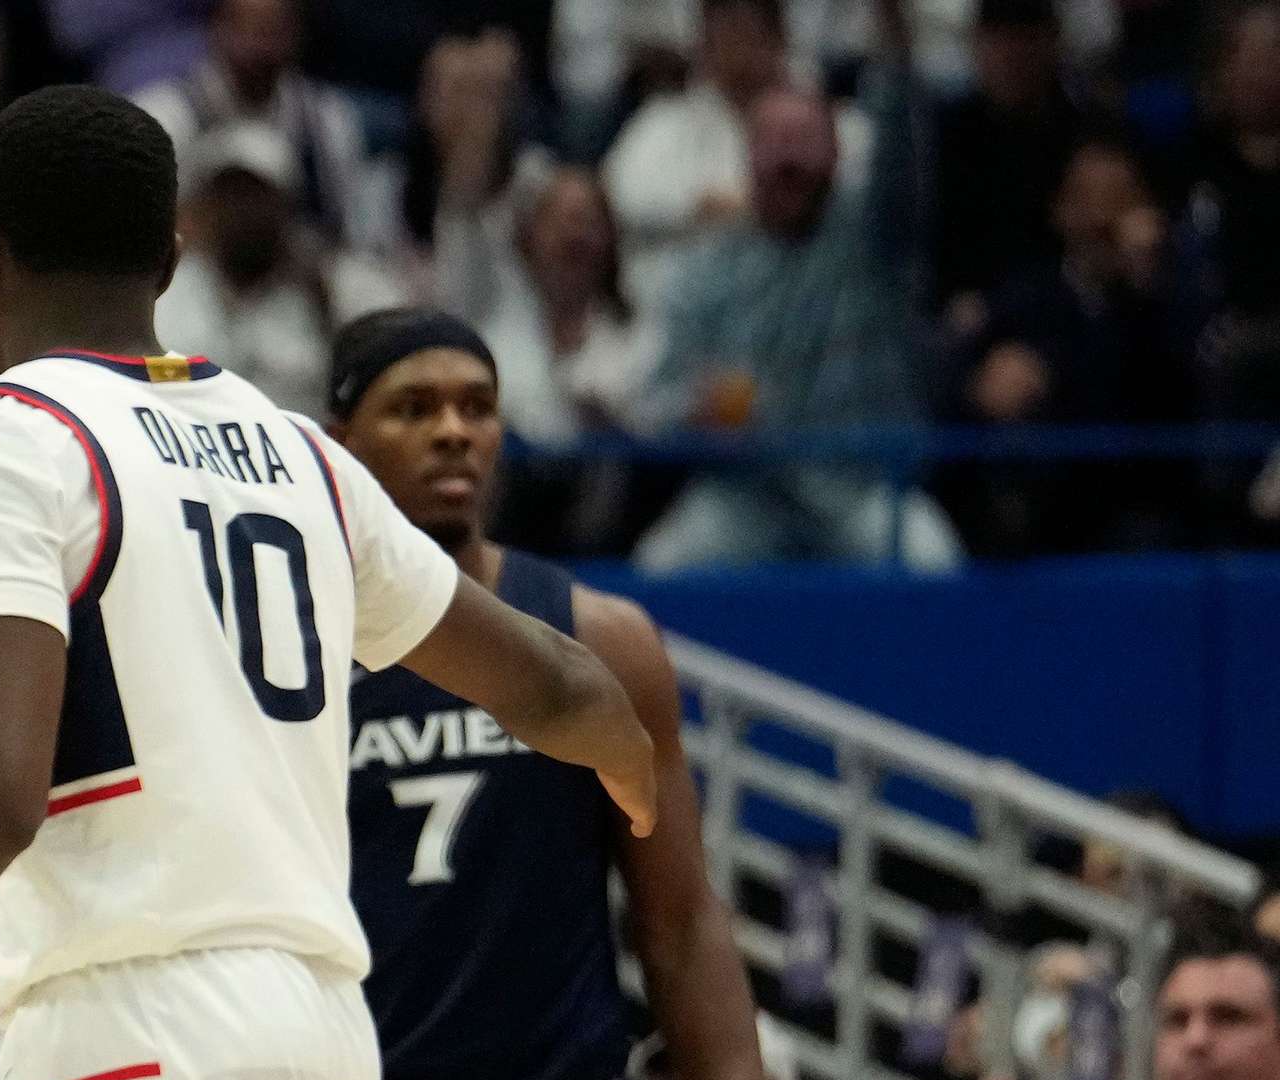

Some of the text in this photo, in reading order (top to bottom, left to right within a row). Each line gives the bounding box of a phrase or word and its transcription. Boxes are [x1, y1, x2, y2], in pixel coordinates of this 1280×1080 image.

[180, 498, 327, 722] 10
[350, 706, 532, 772] AVIE
[389, 769, 488, 887] 7
